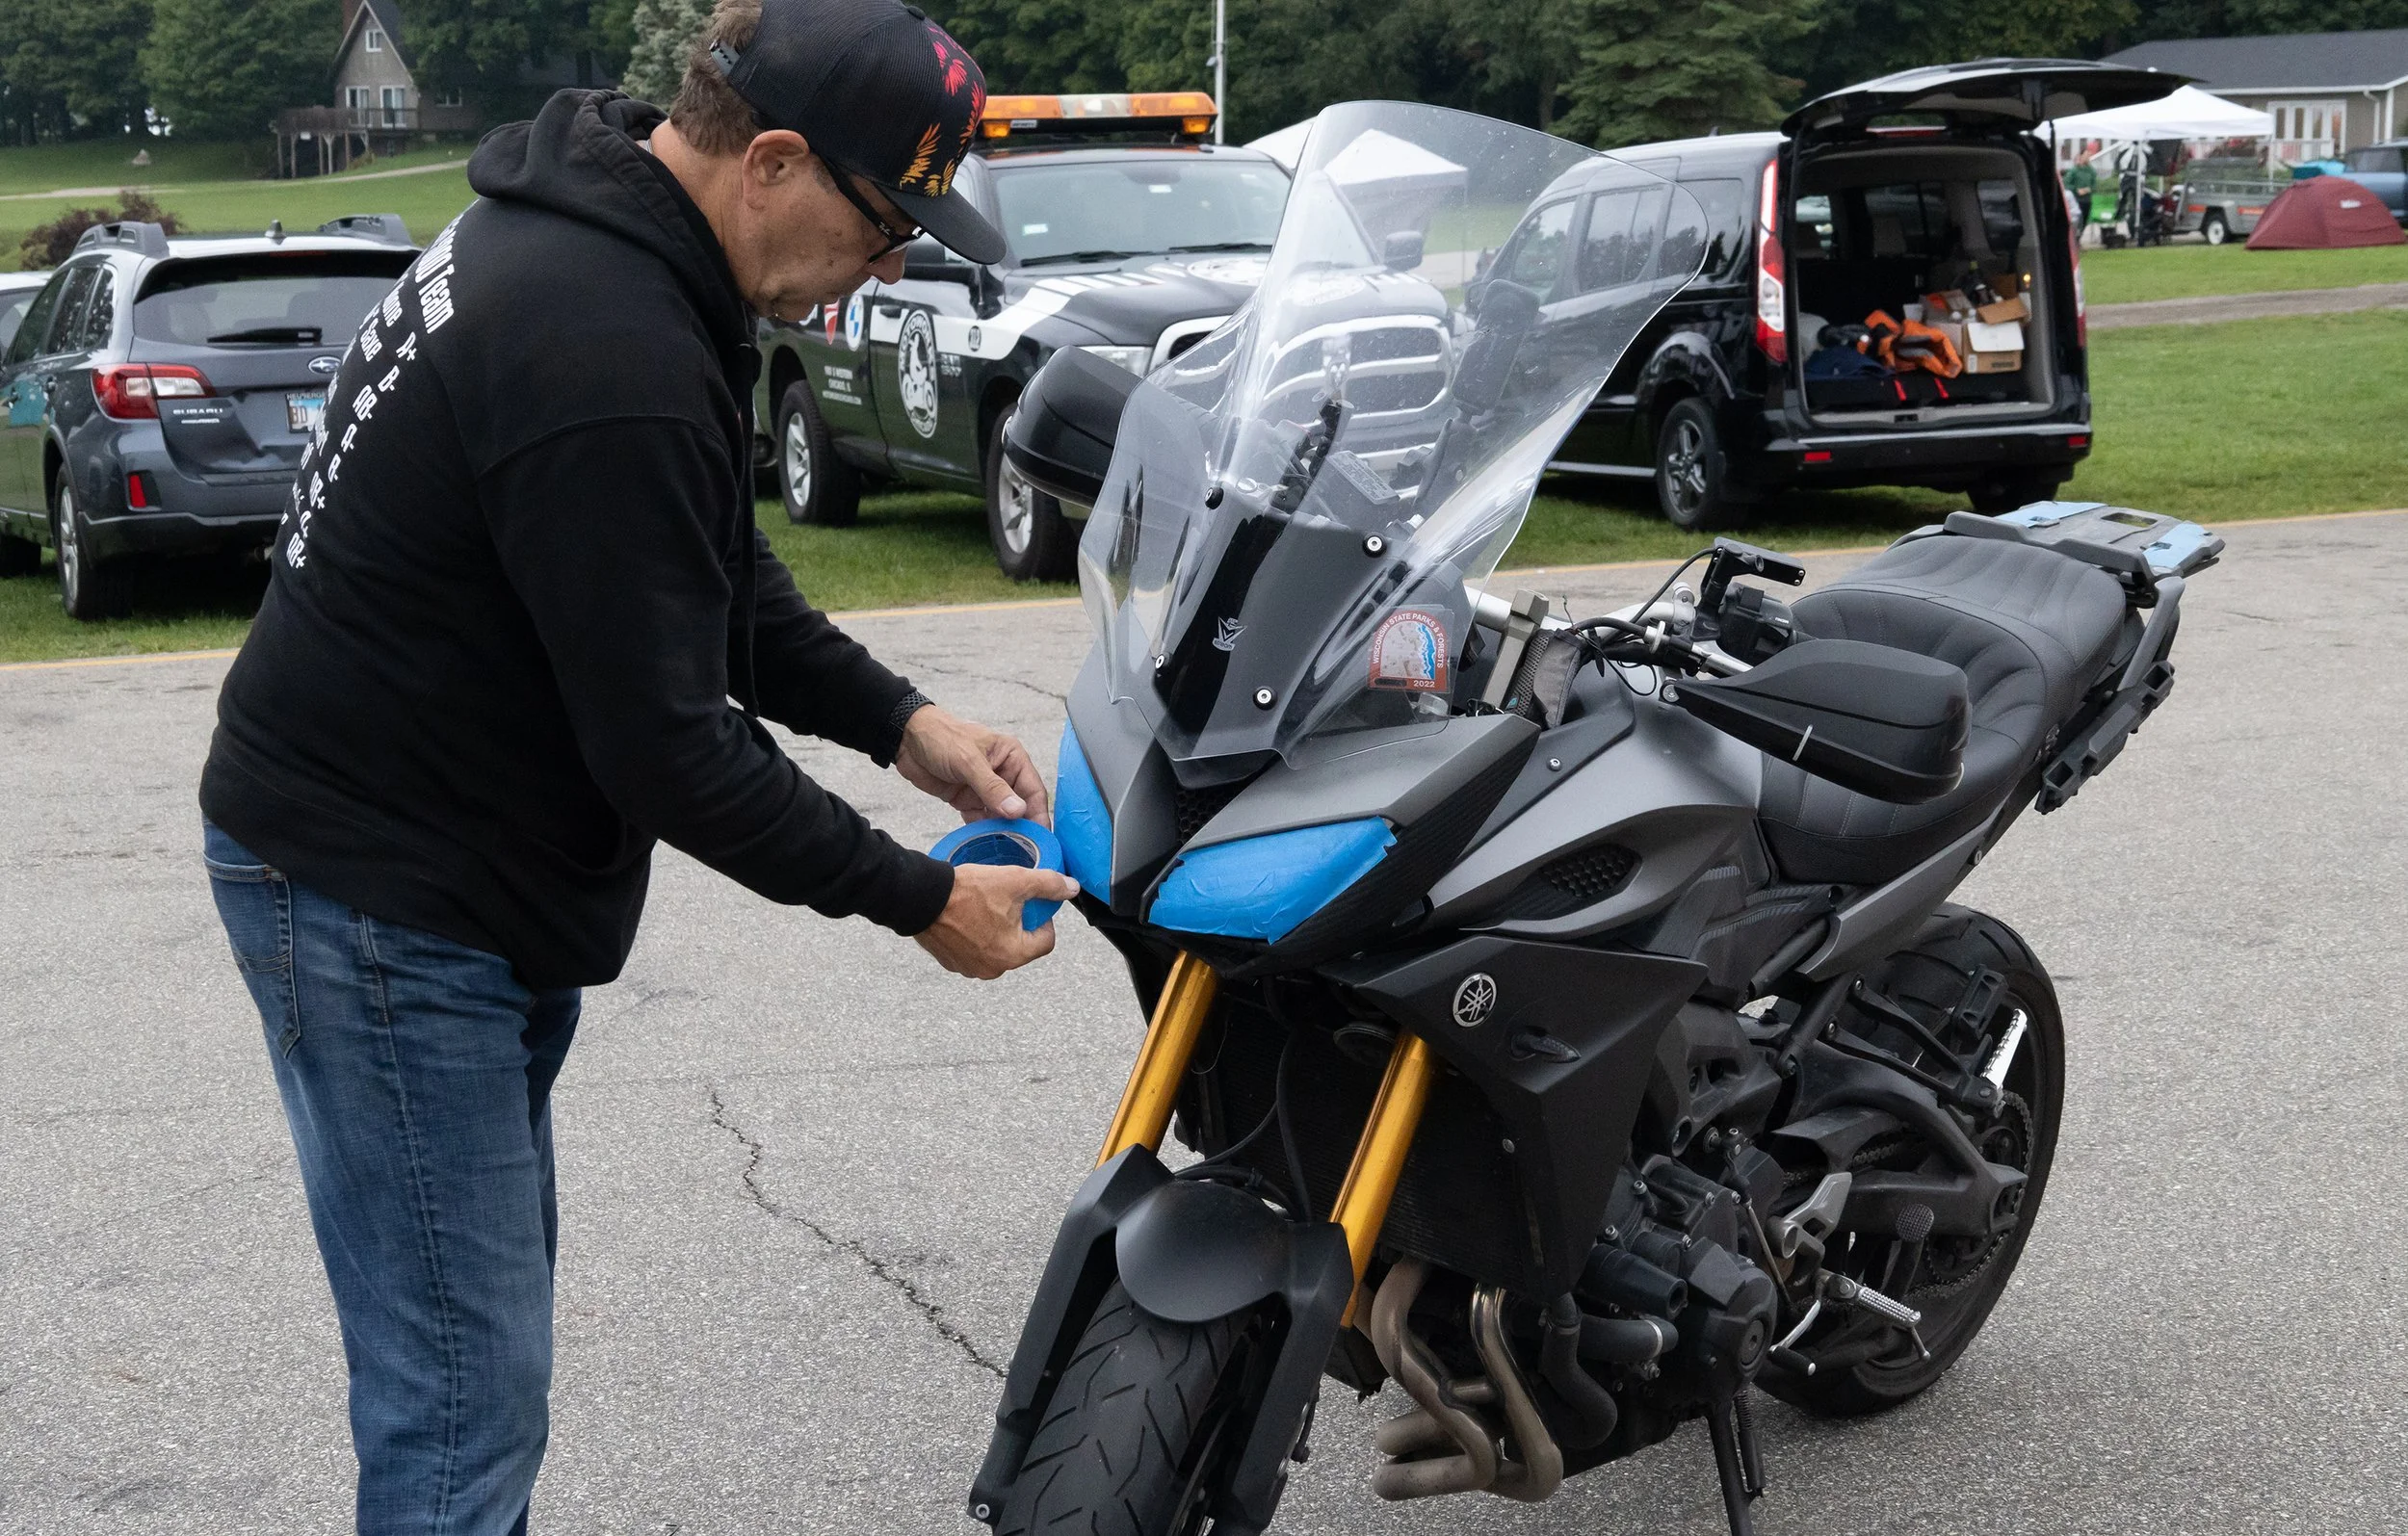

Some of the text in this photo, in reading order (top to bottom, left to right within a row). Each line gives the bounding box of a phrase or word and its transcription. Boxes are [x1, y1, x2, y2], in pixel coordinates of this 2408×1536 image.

[418, 264, 455, 334] Team
[360, 318, 382, 362] Saxe
[396, 331, 417, 361] A+
[378, 365, 400, 393] B-
[353, 384, 378, 421] AB-
[340, 423, 357, 453] A-
[1373, 623, 1390, 664] WISCONSIN
[1389, 612, 1411, 625] STATE
[1412, 612, 1436, 628] PARKS
[1436, 633, 1445, 668] FORESTS
